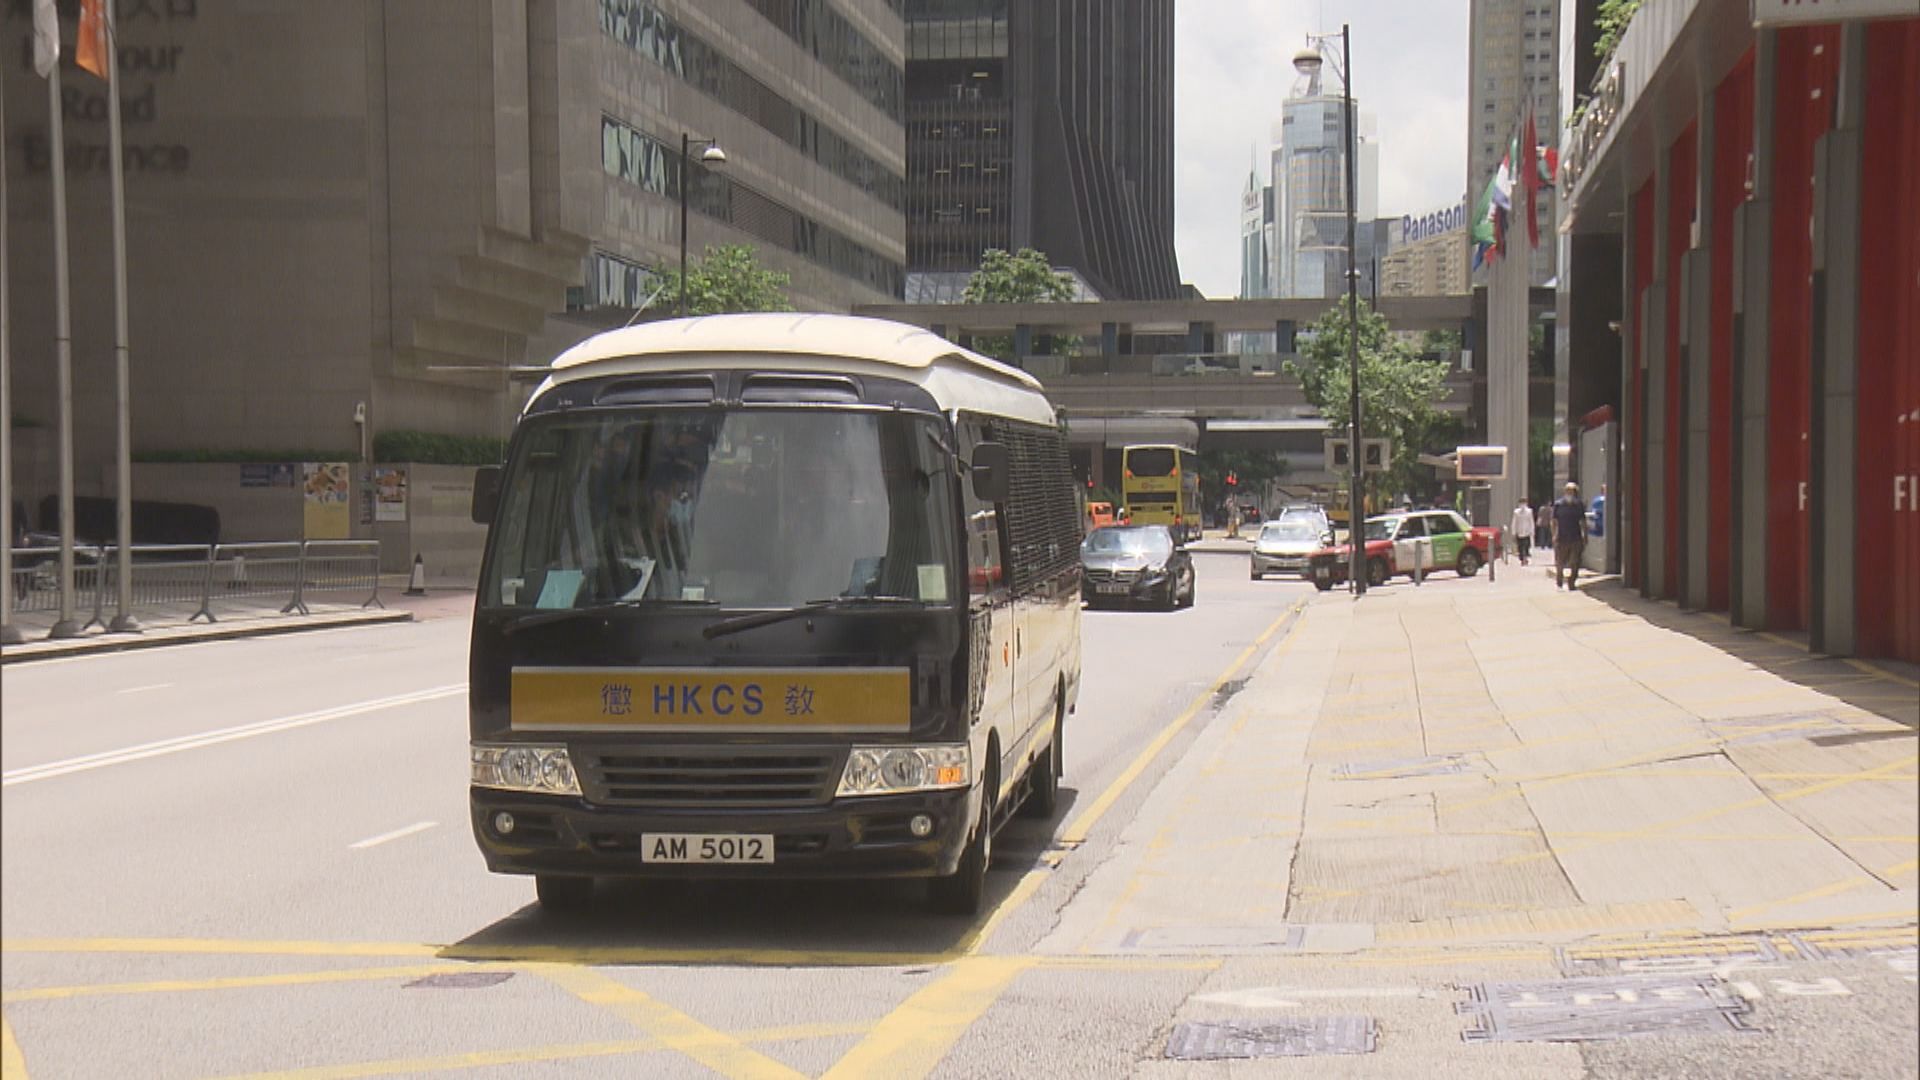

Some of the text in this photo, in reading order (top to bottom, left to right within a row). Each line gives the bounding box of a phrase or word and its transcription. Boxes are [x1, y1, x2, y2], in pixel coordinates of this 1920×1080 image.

[23, 132, 191, 175] Etrance
[1402, 193, 1466, 244] Panasoni
[601, 684, 632, 715] 懲
[653, 684, 764, 715] HKCS
[652, 838, 764, 859] AM 5012
